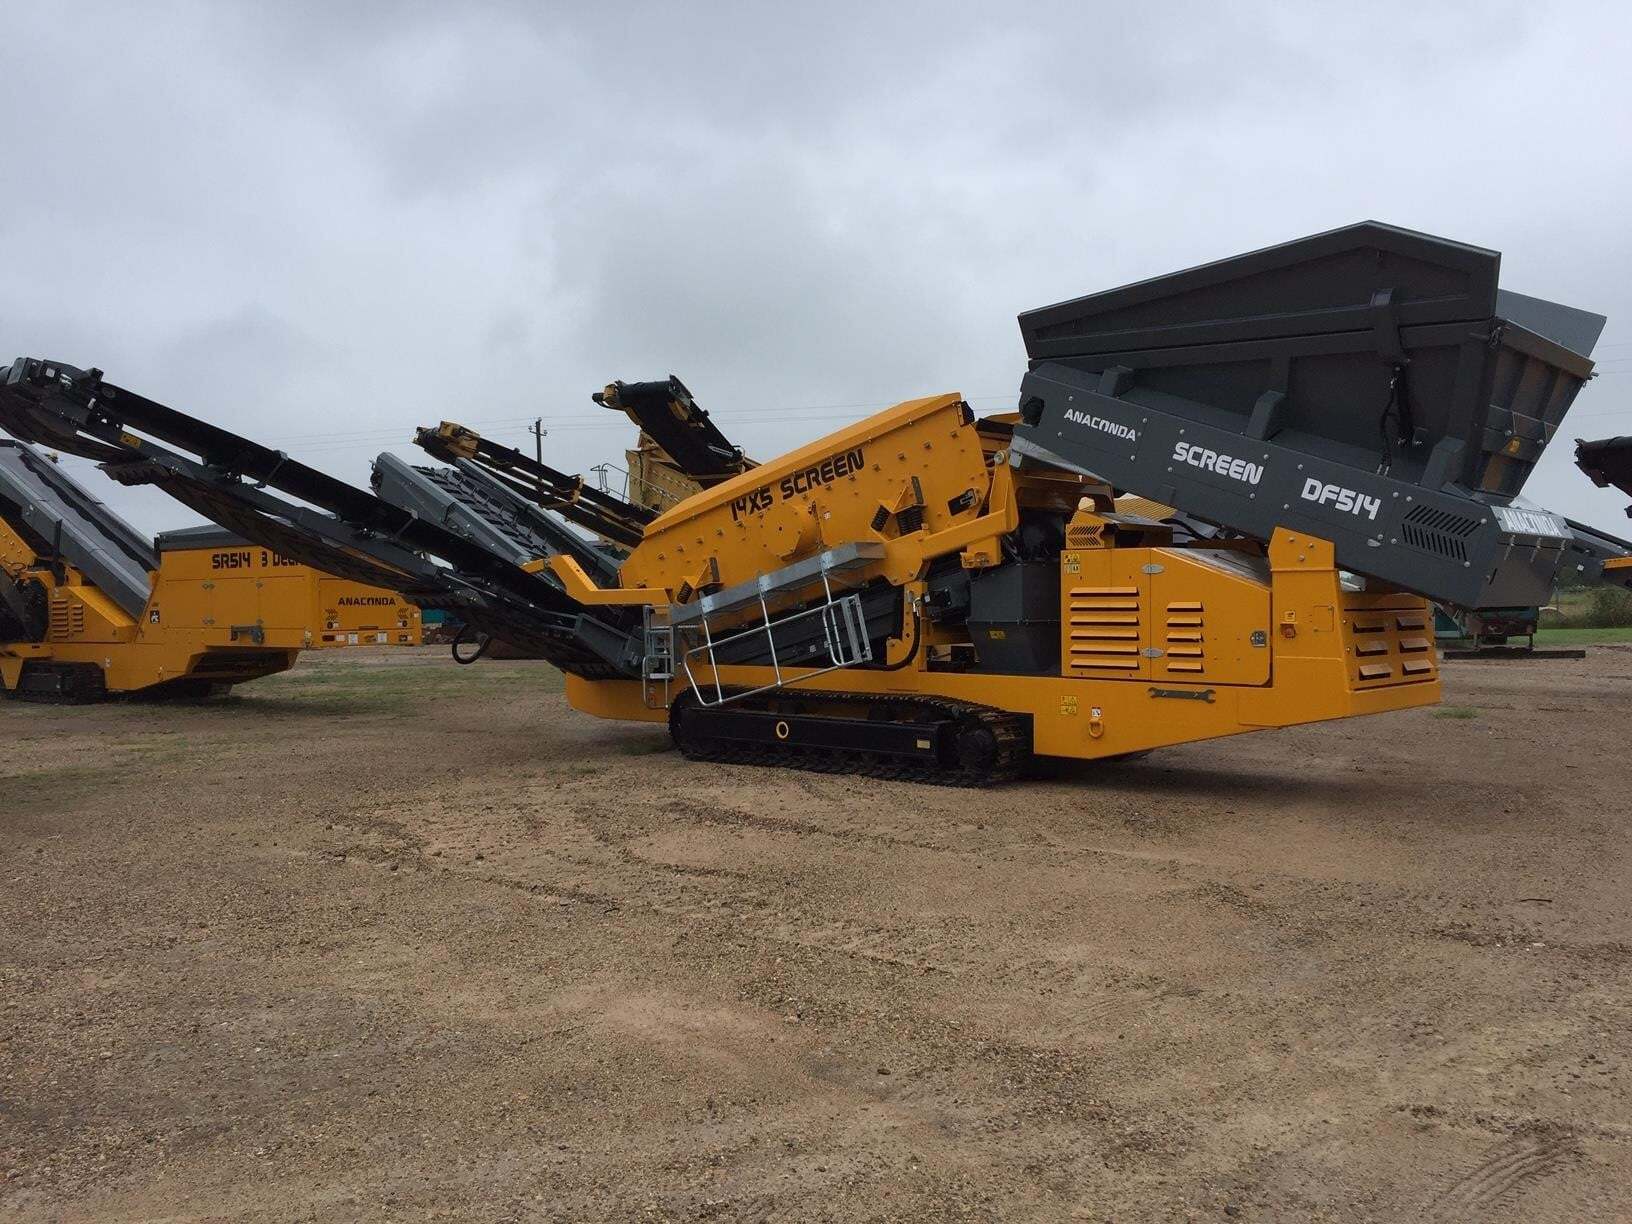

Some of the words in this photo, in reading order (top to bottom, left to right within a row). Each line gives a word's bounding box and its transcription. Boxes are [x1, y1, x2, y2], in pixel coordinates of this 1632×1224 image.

[1063, 407, 1137, 442] ANACONDA
[1172, 441, 1264, 485] SCREEN
[731, 486, 773, 521] 14X5
[780, 448, 865, 500] SCREEN
[1300, 477, 1382, 521] DF514
[212, 552, 251, 569] SR514
[261, 551, 268, 567] 3
[337, 597, 397, 606] ANACONDA
